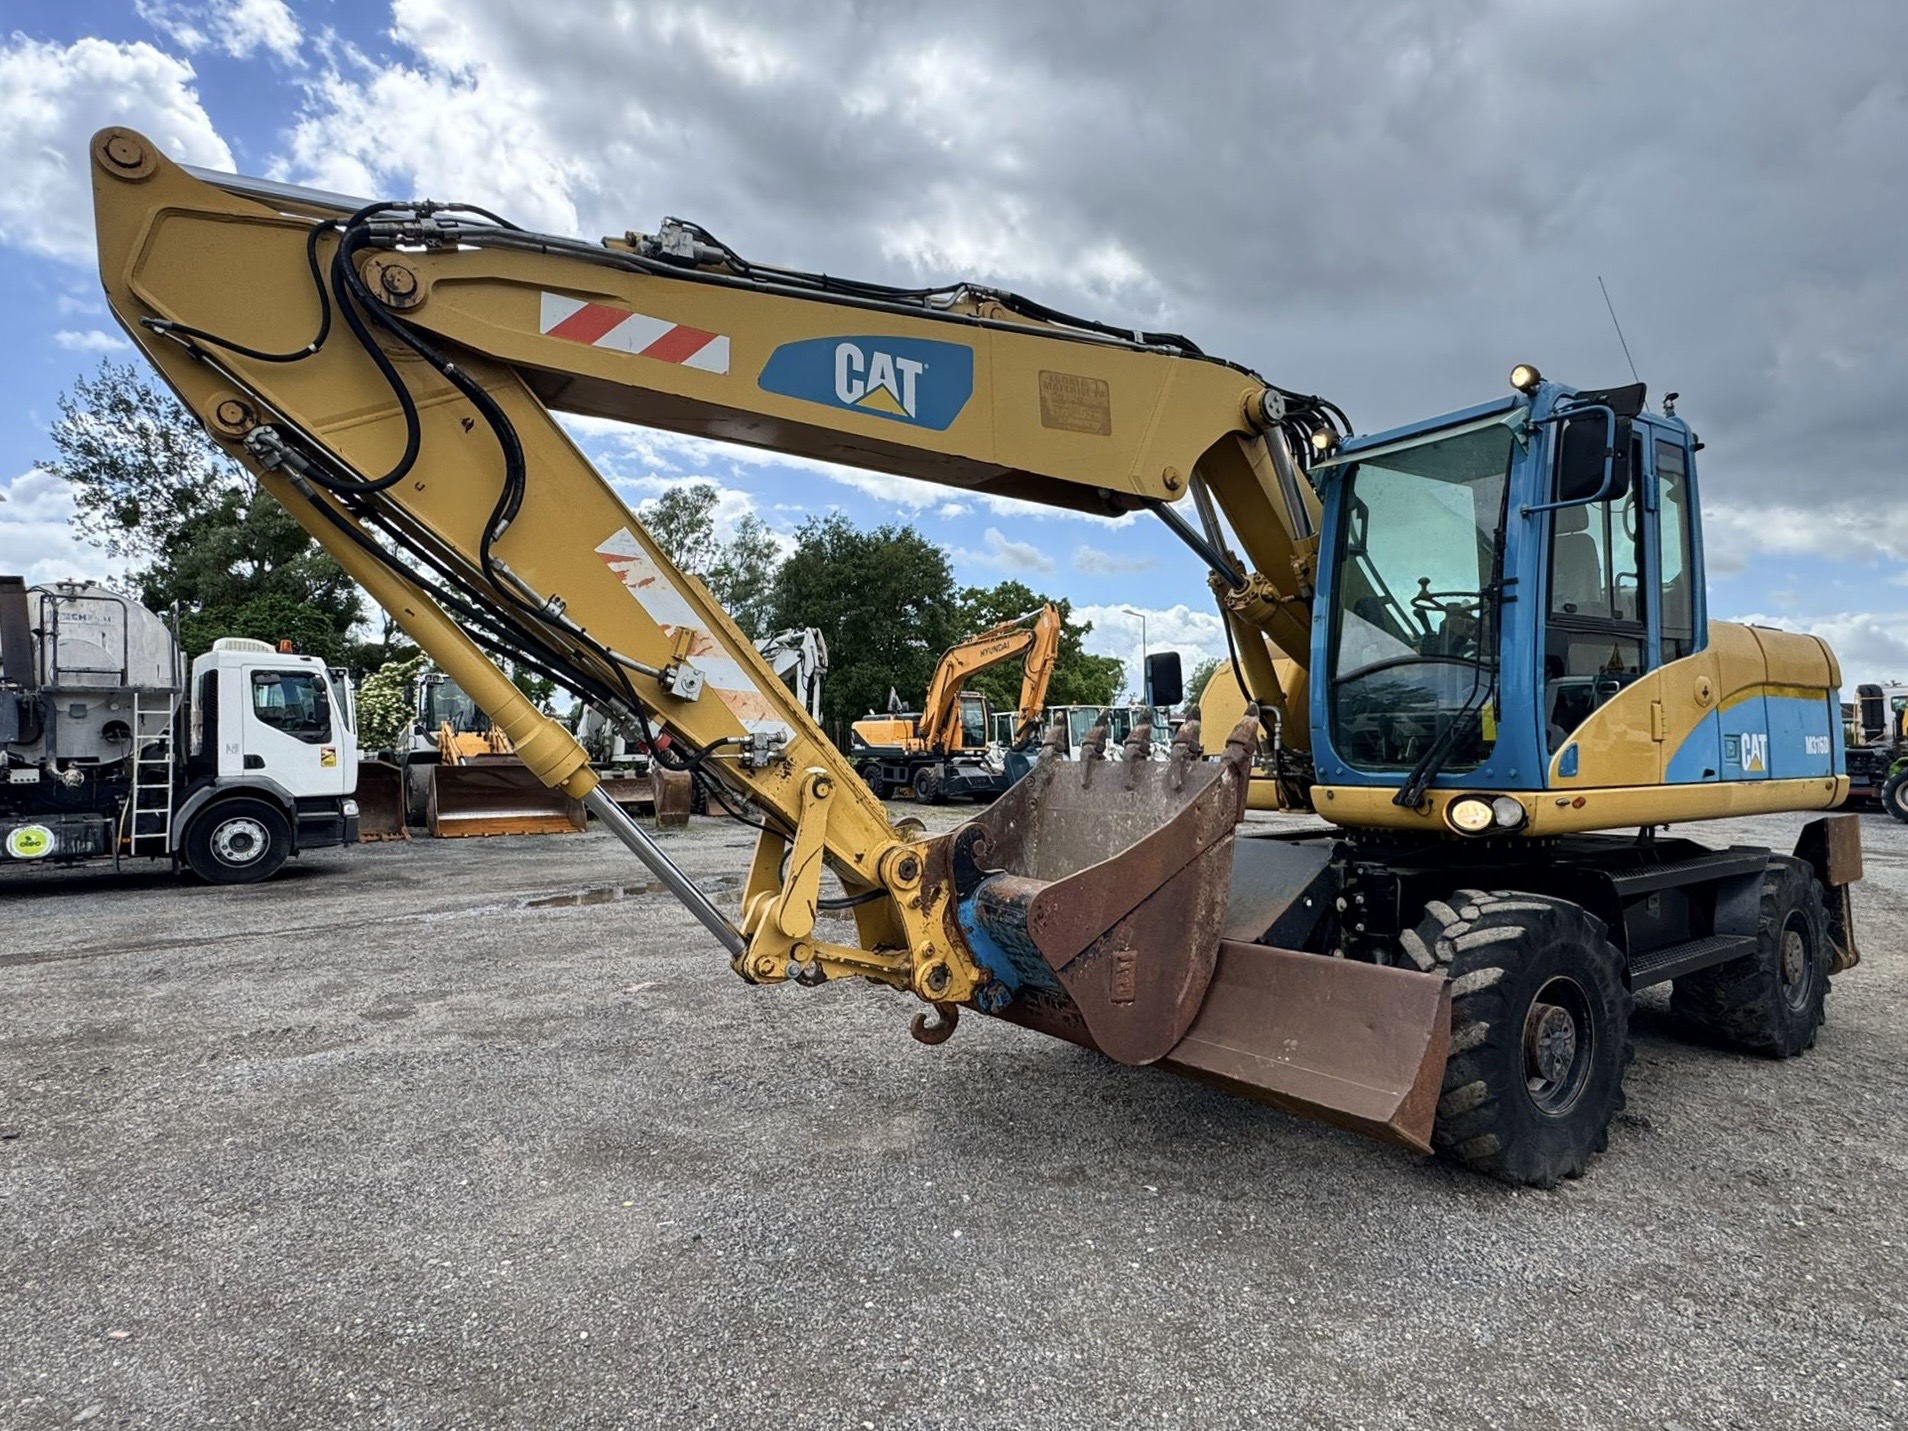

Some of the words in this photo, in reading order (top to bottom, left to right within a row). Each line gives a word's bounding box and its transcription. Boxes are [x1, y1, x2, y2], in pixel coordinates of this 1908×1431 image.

[834, 342, 924, 419] CAT
[980, 641, 1010, 657] HYUNDAI
[1741, 732, 1767, 771] CAT
